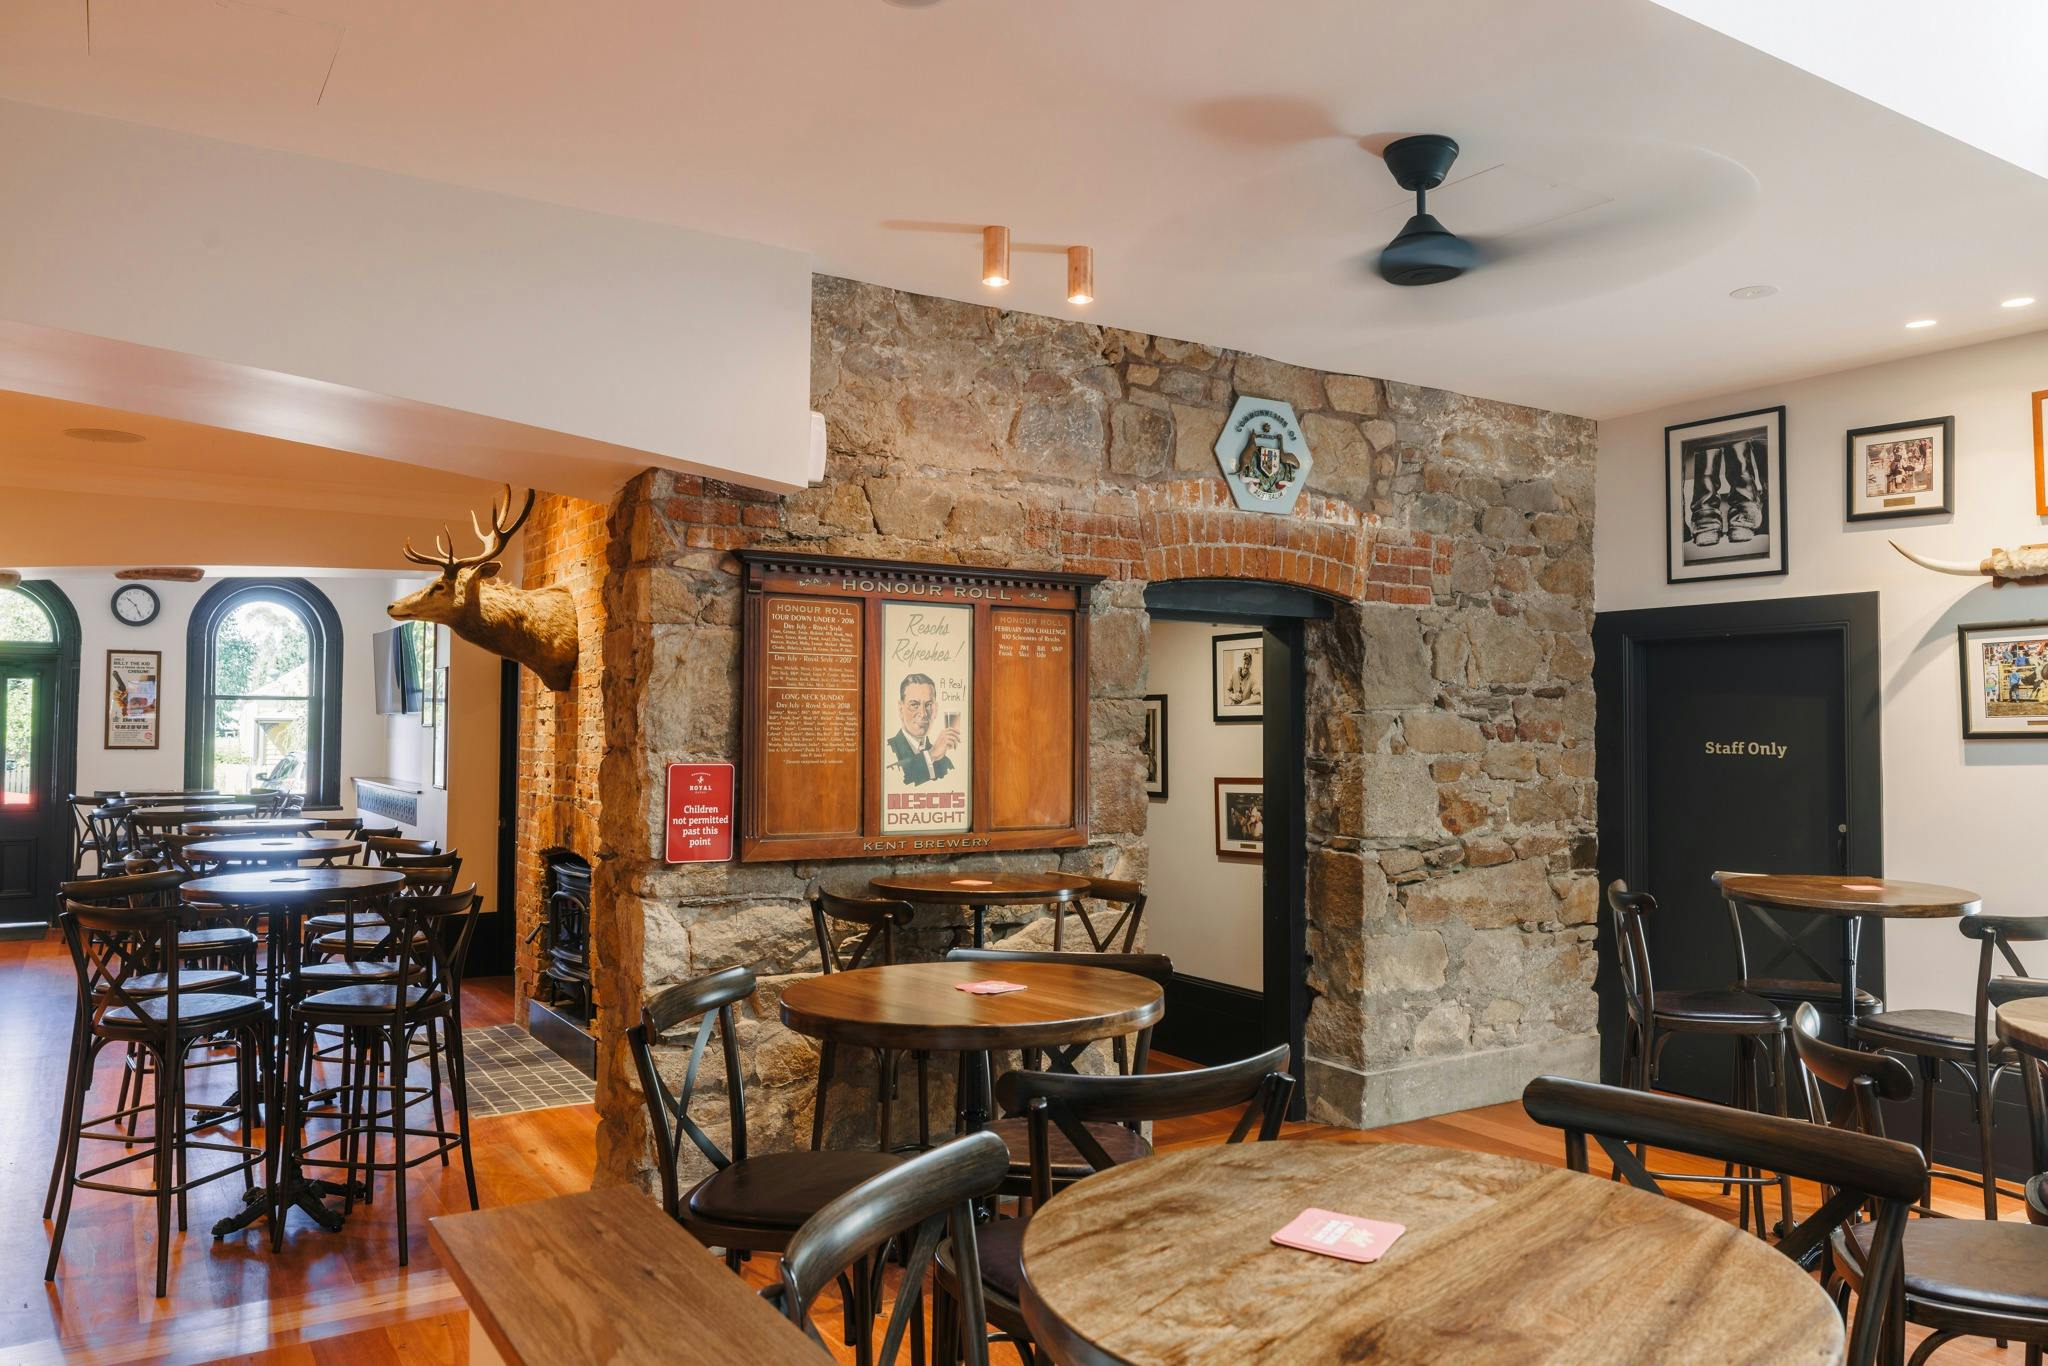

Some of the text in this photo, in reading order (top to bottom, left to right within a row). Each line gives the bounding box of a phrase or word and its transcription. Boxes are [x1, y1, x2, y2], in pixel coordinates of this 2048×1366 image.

[842, 579, 1012, 601] HONOUR ROLL
[777, 604, 852, 616] HONOUR ROLL
[791, 614, 812, 622] DOWN
[813, 615, 836, 624] UNDER
[906, 613, 950, 636] Reschs
[1000, 616, 1037, 625] HONOUR
[994, 625, 1023, 633] FEBRUARY
[1035, 627, 1066, 636] CHALLENGE
[781, 693, 845, 701] LONG NECK SUNDAY
[1705, 741, 1788, 759] Staff Only
[683, 804, 719, 814] Children
[672, 815, 729, 827] not permitted
[887, 811, 965, 825] DRAUGHT
[682, 826, 719, 838] past this
[689, 837, 712, 848] point
[863, 837, 992, 852] KENT BREWERY
